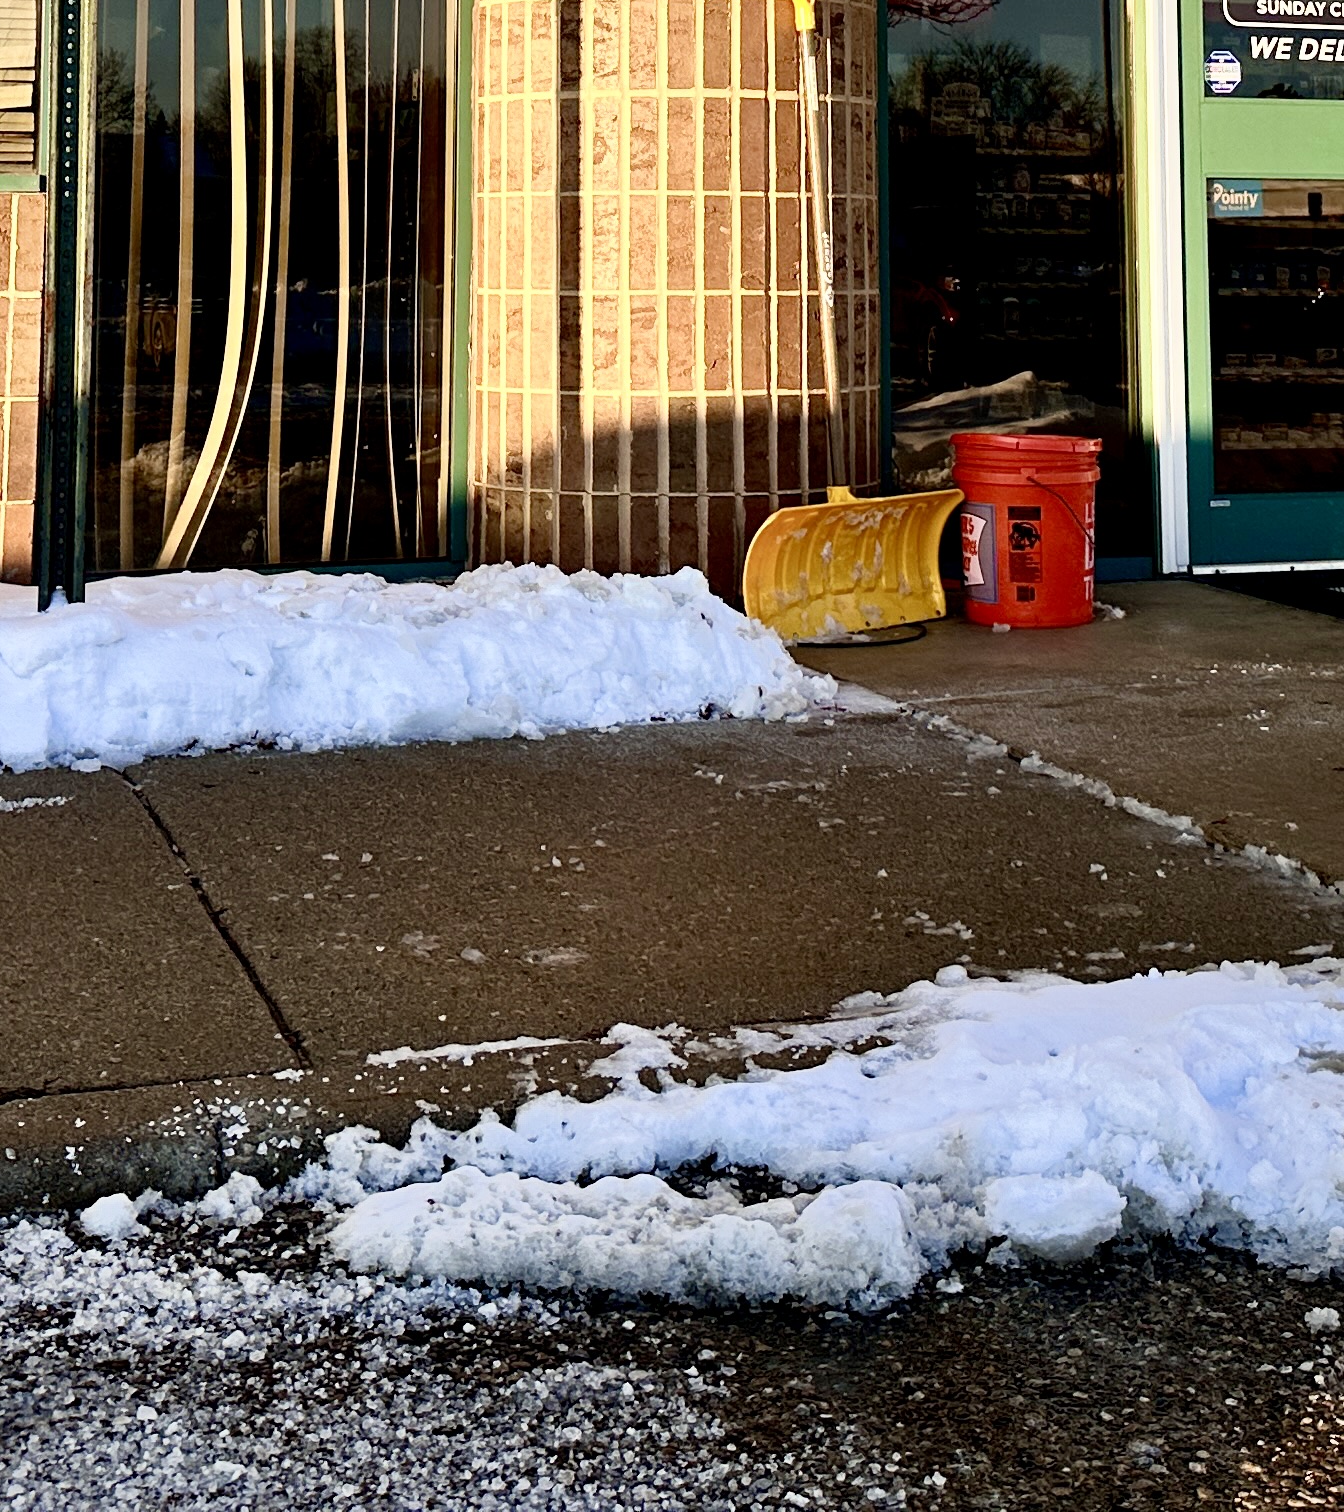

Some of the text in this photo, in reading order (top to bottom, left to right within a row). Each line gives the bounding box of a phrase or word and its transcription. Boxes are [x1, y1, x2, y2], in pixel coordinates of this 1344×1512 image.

[1256, 0, 1327, 17] SUNDAY
[1250, 36, 1293, 60] WE
[1213, 183, 1259, 208] Pointy
